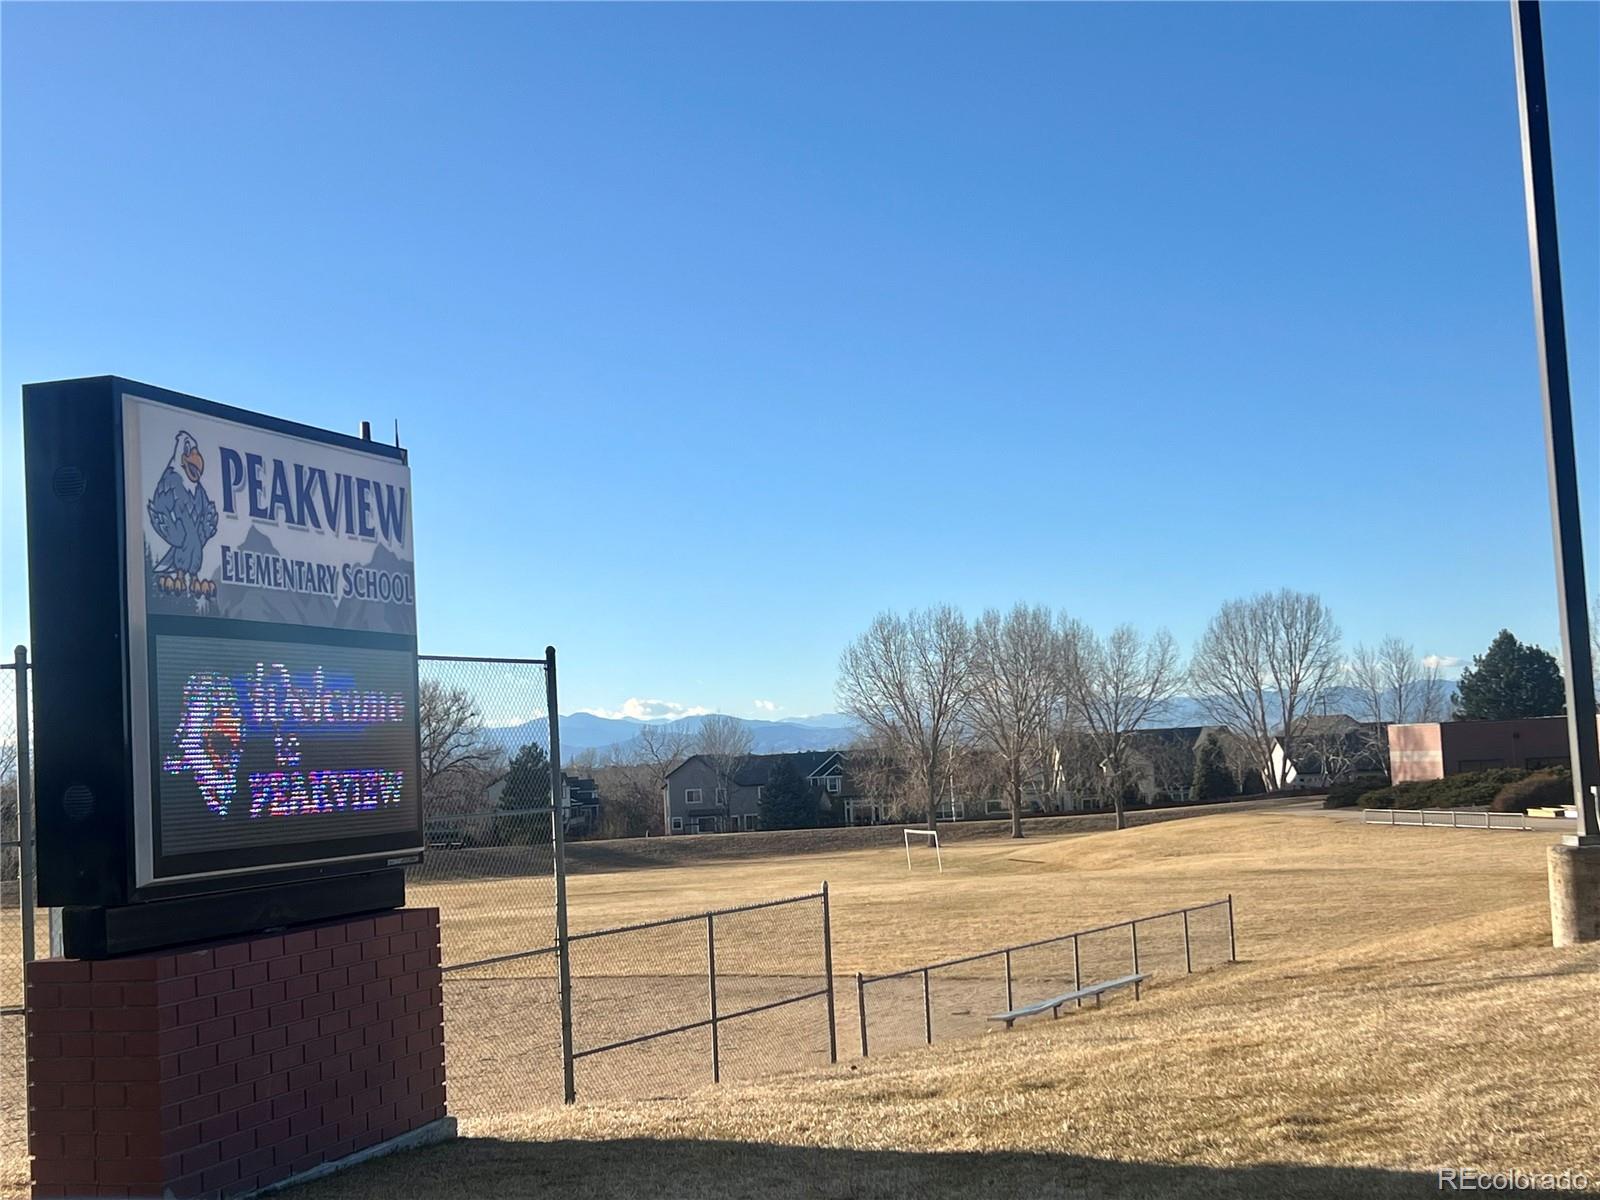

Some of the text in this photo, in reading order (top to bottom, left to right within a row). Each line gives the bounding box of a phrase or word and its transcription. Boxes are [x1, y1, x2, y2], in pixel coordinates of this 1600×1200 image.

[219, 446, 406, 544] PEAKVIEW
[220, 545, 413, 603] ELEMENTARY SCHOOL
